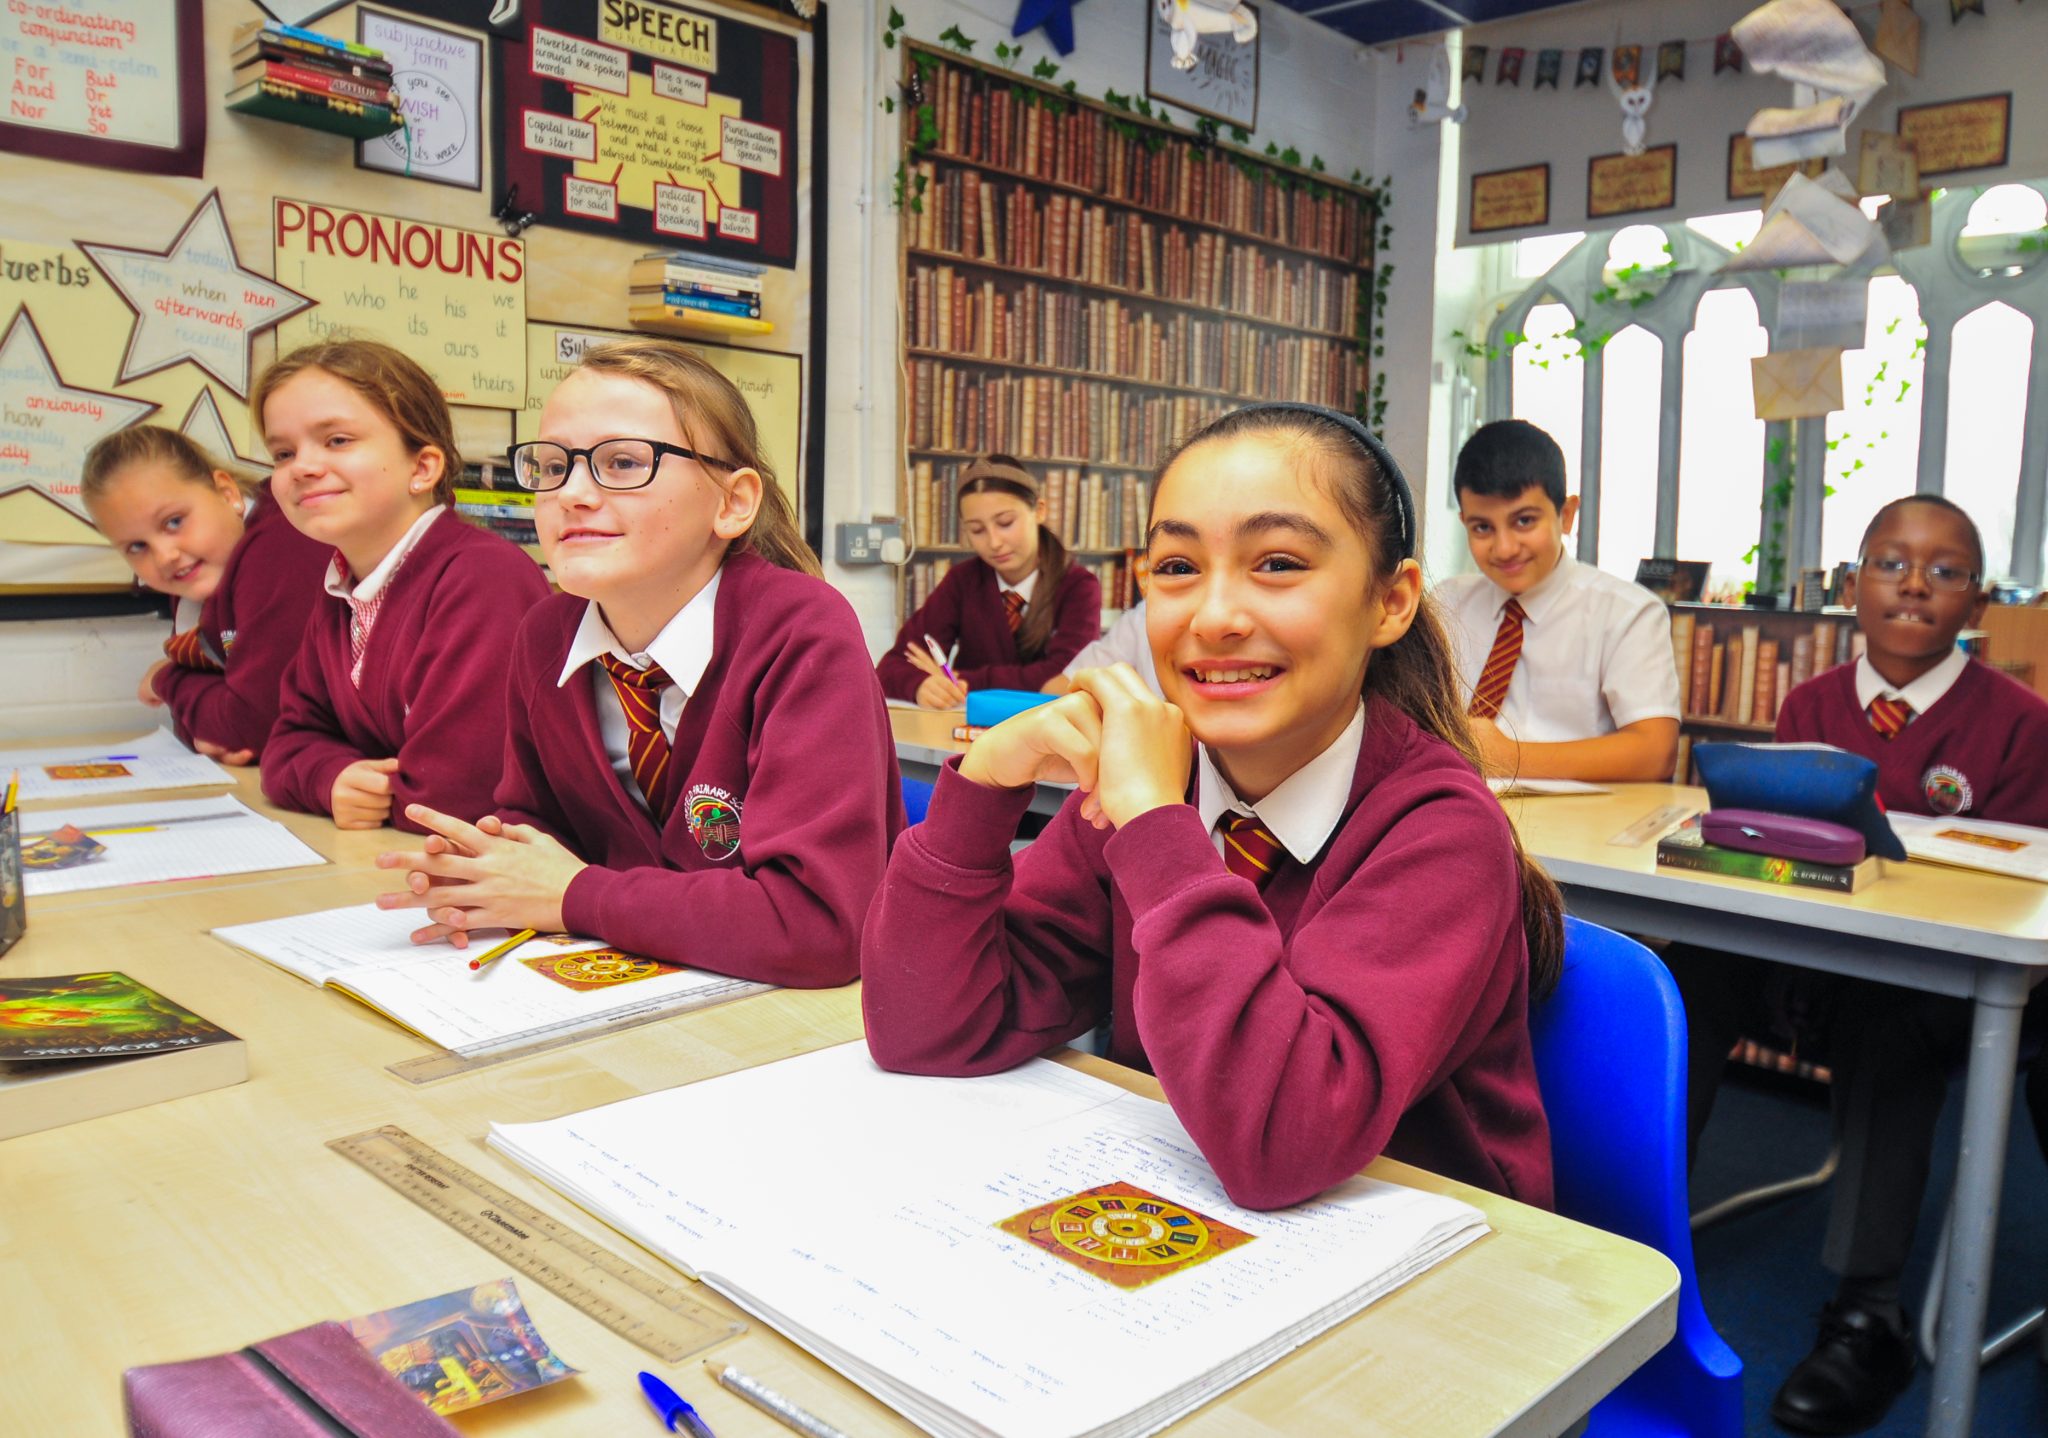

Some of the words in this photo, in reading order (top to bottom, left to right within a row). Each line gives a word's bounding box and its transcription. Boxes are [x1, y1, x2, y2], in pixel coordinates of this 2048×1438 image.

[19, 21, 123, 49] conjunction
[604, 0, 709, 52] SPEECH
[375, 23, 466, 58] subjunctive
[536, 32, 577, 54] Inverted
[580, 46, 619, 65] commas
[14, 56, 49, 80] For
[412, 48, 448, 70] form
[535, 48, 571, 66] around
[576, 57, 590, 71] the
[594, 62, 626, 79] spoken
[535, 60, 565, 77] words
[12, 79, 55, 100] And
[86, 69, 117, 88] But
[407, 77, 428, 90] you
[656, 69, 673, 83] Use
[676, 75, 682, 84] a
[685, 79, 702, 91] new
[667, 83, 684, 97] line
[85, 87, 107, 101] Or
[435, 86, 450, 100] see
[10, 99, 46, 119] Nor
[88, 103, 113, 119] Yet
[87, 118, 108, 134] So
[527, 116, 563, 135] Capital
[567, 125, 591, 140] letter
[625, 107, 648, 122] must
[676, 118, 704, 135] choose
[534, 133, 544, 143] to
[549, 135, 574, 152] start
[600, 116, 640, 136] between
[645, 127, 668, 142] what
[672, 134, 680, 144] is
[684, 138, 707, 152] right
[723, 121, 775, 145] Punctuation
[609, 135, 628, 146] and
[635, 140, 658, 153] what
[663, 147, 672, 156] is
[724, 135, 749, 150] before
[751, 142, 778, 161] closing
[600, 147, 636, 163] advised
[641, 154, 691, 173] Dumbledore
[570, 195, 583, 210] for
[587, 199, 608, 211] said
[658, 190, 696, 204] indicate
[659, 202, 678, 213] who
[682, 203, 690, 214] is
[658, 212, 699, 233] speaking
[741, 213, 751, 224] an
[277, 200, 523, 284] PRONOUNS
[185, 247, 228, 272] today
[122, 258, 173, 287] before
[299, 260, 307, 289] I
[182, 280, 227, 303] when
[242, 289, 276, 309] then
[344, 284, 386, 310] who
[399, 275, 418, 301] he
[154, 296, 244, 330] afterwards
[444, 296, 467, 319] his
[493, 293, 515, 310] we
[408, 314, 429, 337] its
[495, 319, 507, 339] it
[444, 341, 480, 359] ours
[472, 370, 515, 394] theirs
[26, 395, 104, 422] anxiously
[527, 397, 543, 410] as
[3, 403, 44, 428] how
